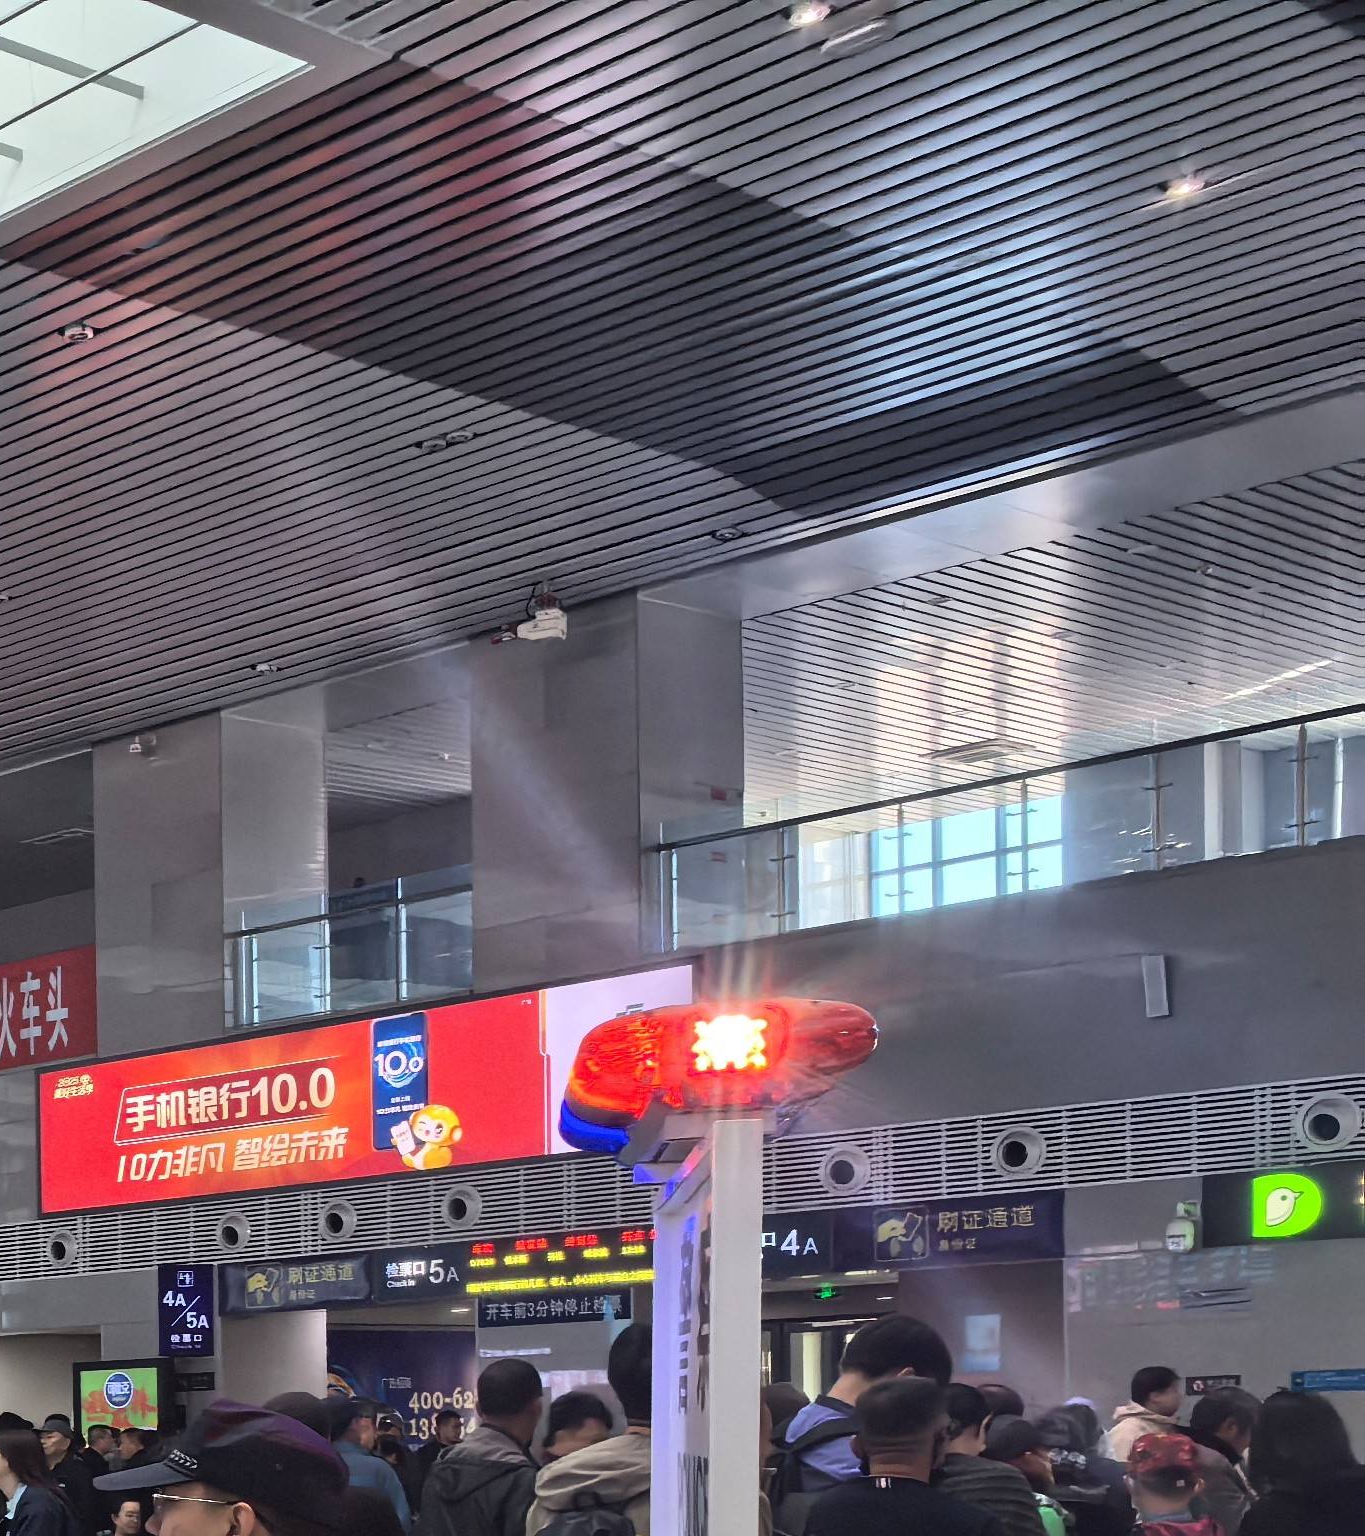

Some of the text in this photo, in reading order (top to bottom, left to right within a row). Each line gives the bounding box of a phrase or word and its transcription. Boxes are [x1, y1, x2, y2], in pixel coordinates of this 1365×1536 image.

[374, 1051, 424, 1077] 10.0
[126, 1067, 336, 1132] 手机银行10.0
[117, 1127, 349, 1183] 10力非凡 智绘未来
[937, 1205, 1034, 1232] 刷证通道
[780, 1229, 818, 1256] 4A
[385, 1260, 425, 1278] 检票口
[429, 1259, 460, 1284] 5A
[163, 1291, 186, 1307] 4A
[186, 1312, 209, 1329] 5A
[409, 1387, 475, 1414] 400-62
